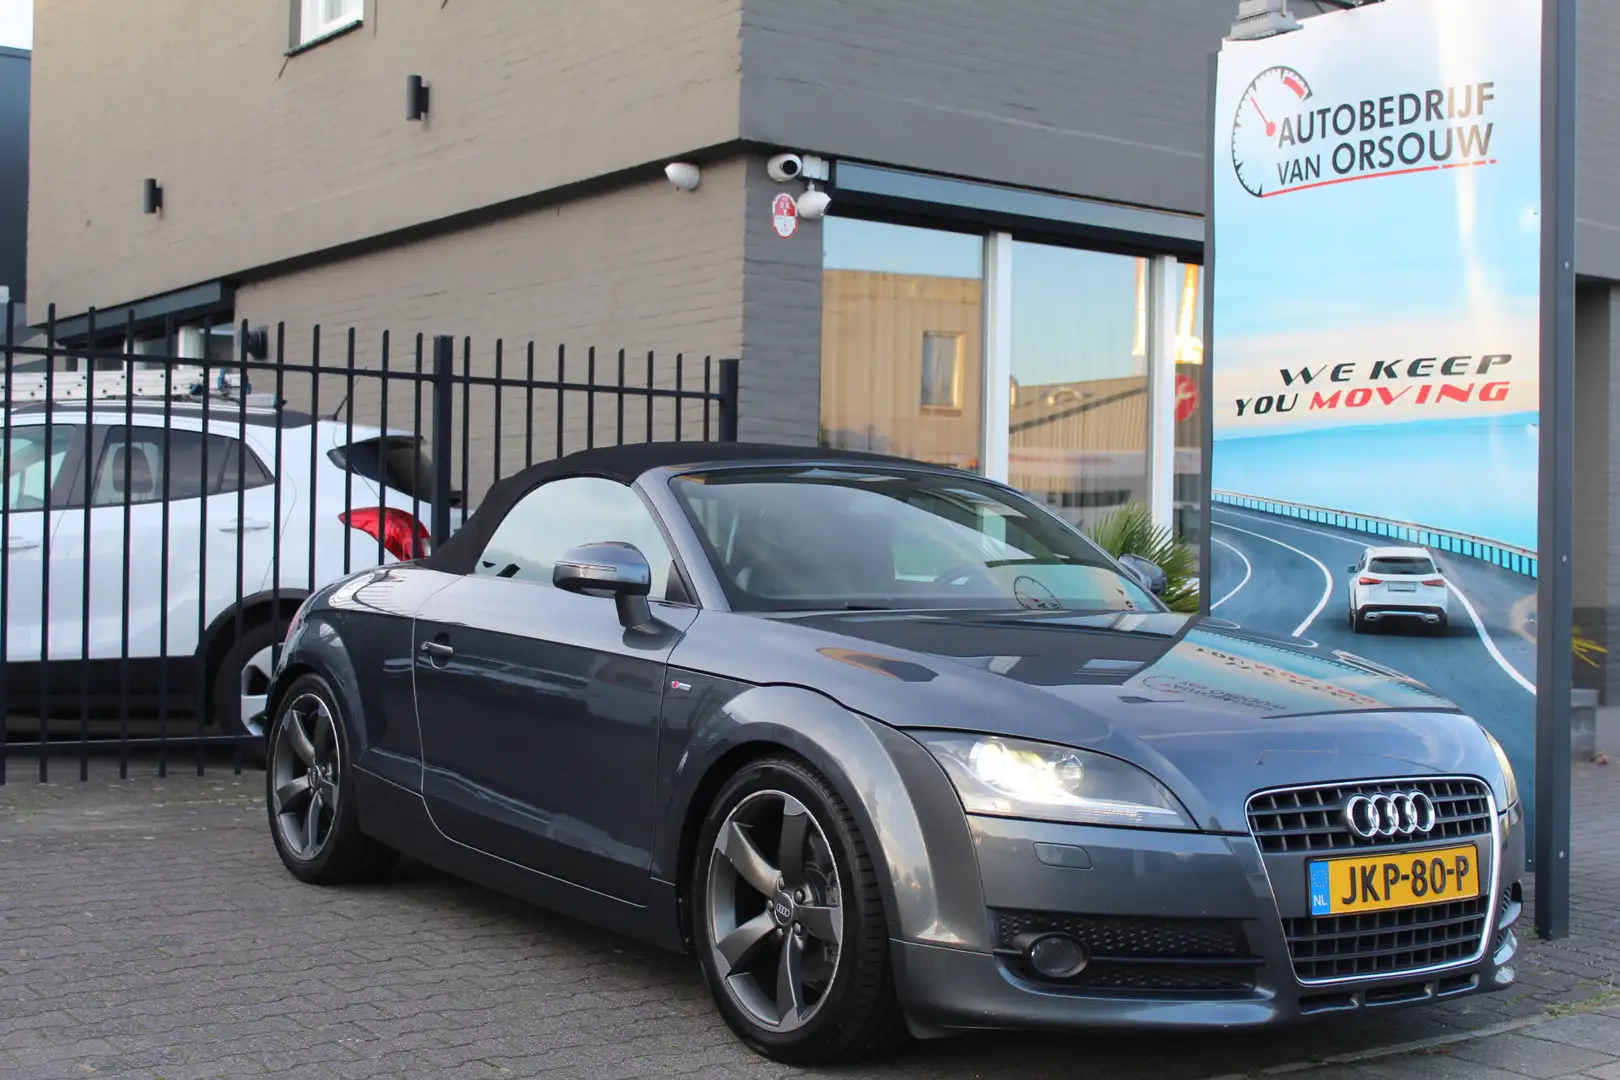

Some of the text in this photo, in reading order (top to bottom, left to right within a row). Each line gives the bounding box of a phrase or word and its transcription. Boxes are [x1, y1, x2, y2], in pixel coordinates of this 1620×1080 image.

[1278, 81, 1494, 149] AUTOBEDRIJF
[1277, 123, 1494, 186] VAN ORSOUW
[1279, 353, 1512, 387] WE KEEP
[1235, 381, 1511, 417] YOU MOVING
[1313, 895, 1328, 906] NL
[1341, 855, 1470, 905] JKP-80-P
